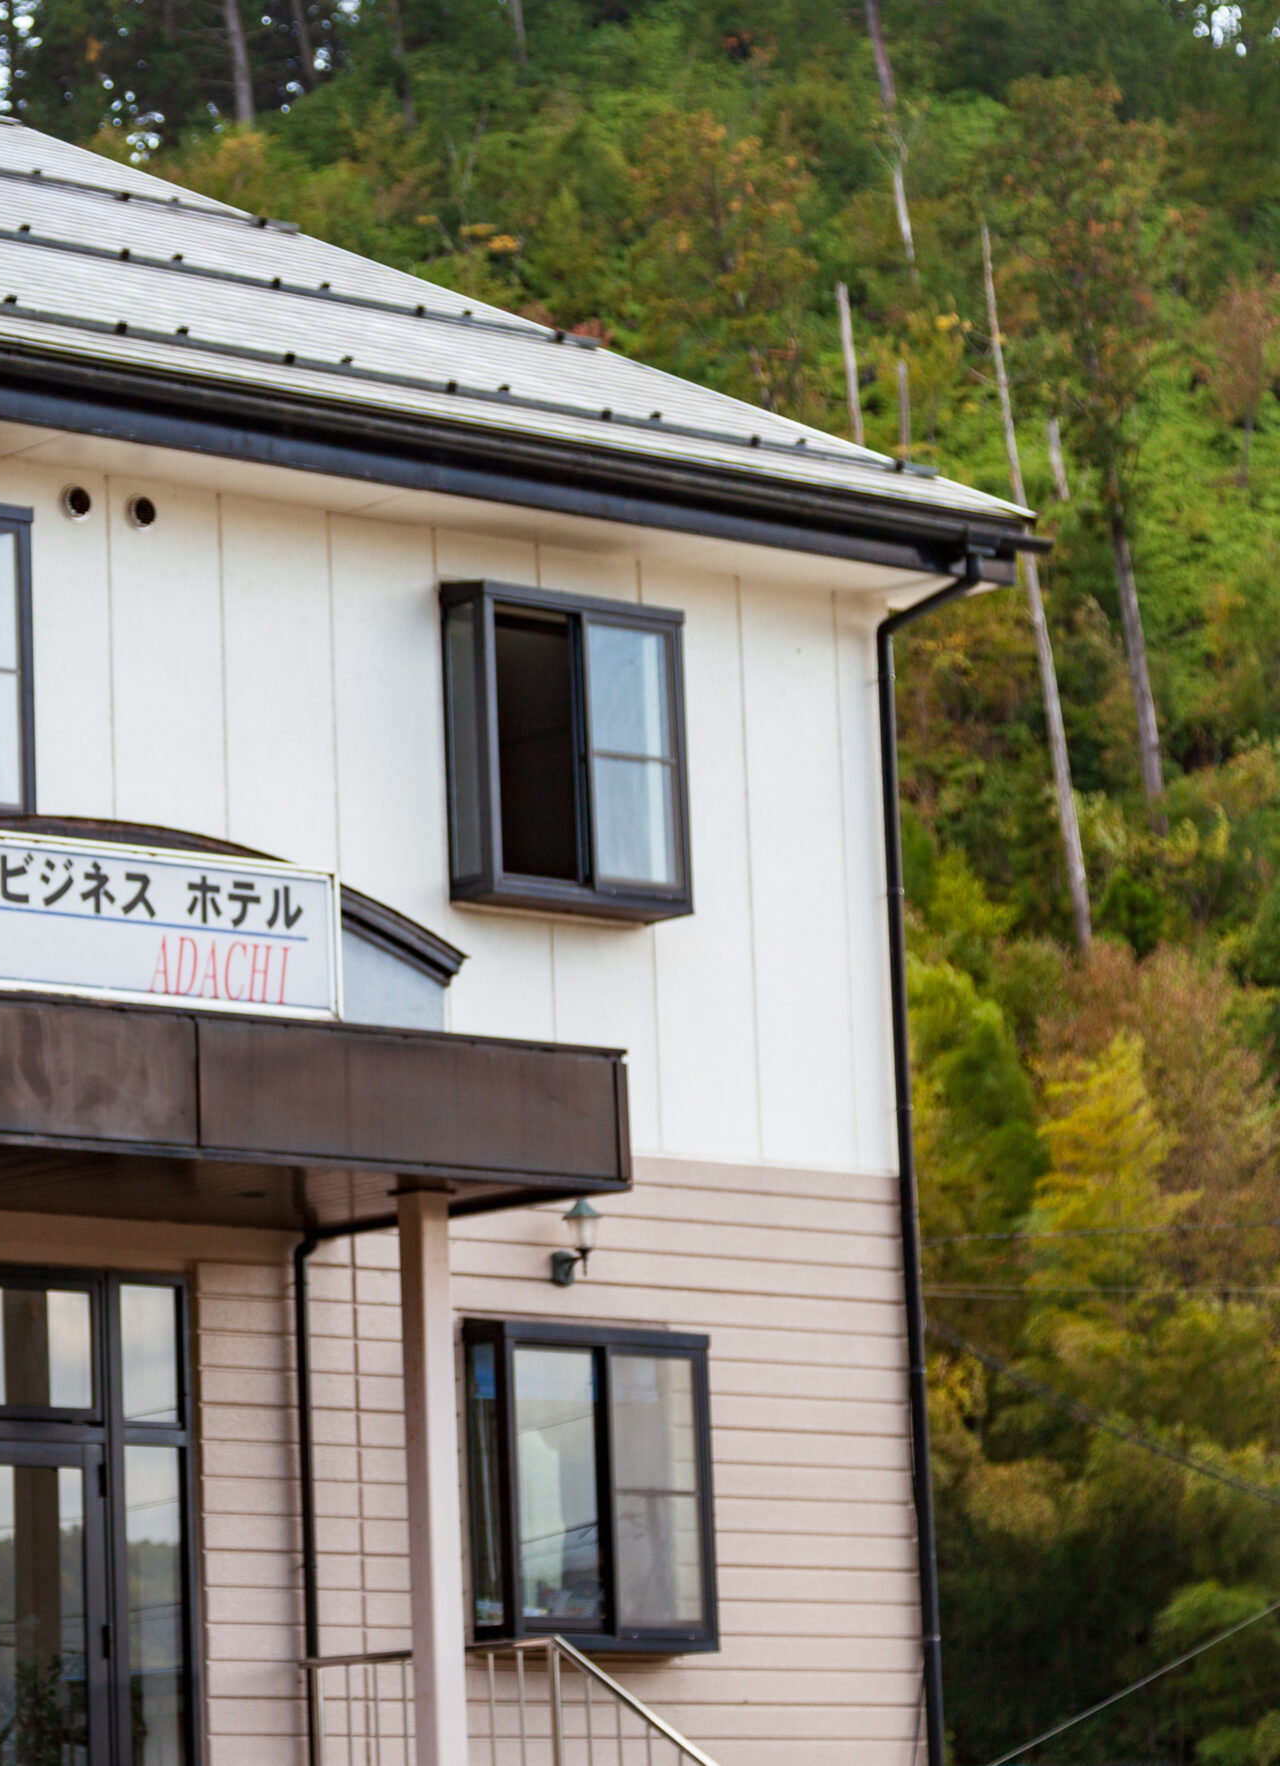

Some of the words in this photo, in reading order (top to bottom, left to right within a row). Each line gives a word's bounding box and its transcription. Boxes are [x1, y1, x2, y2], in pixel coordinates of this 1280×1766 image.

[0, 854, 156, 918] ビジネス
[186, 875, 303, 929] ホテル
[149, 934, 291, 1005] ADACHI
